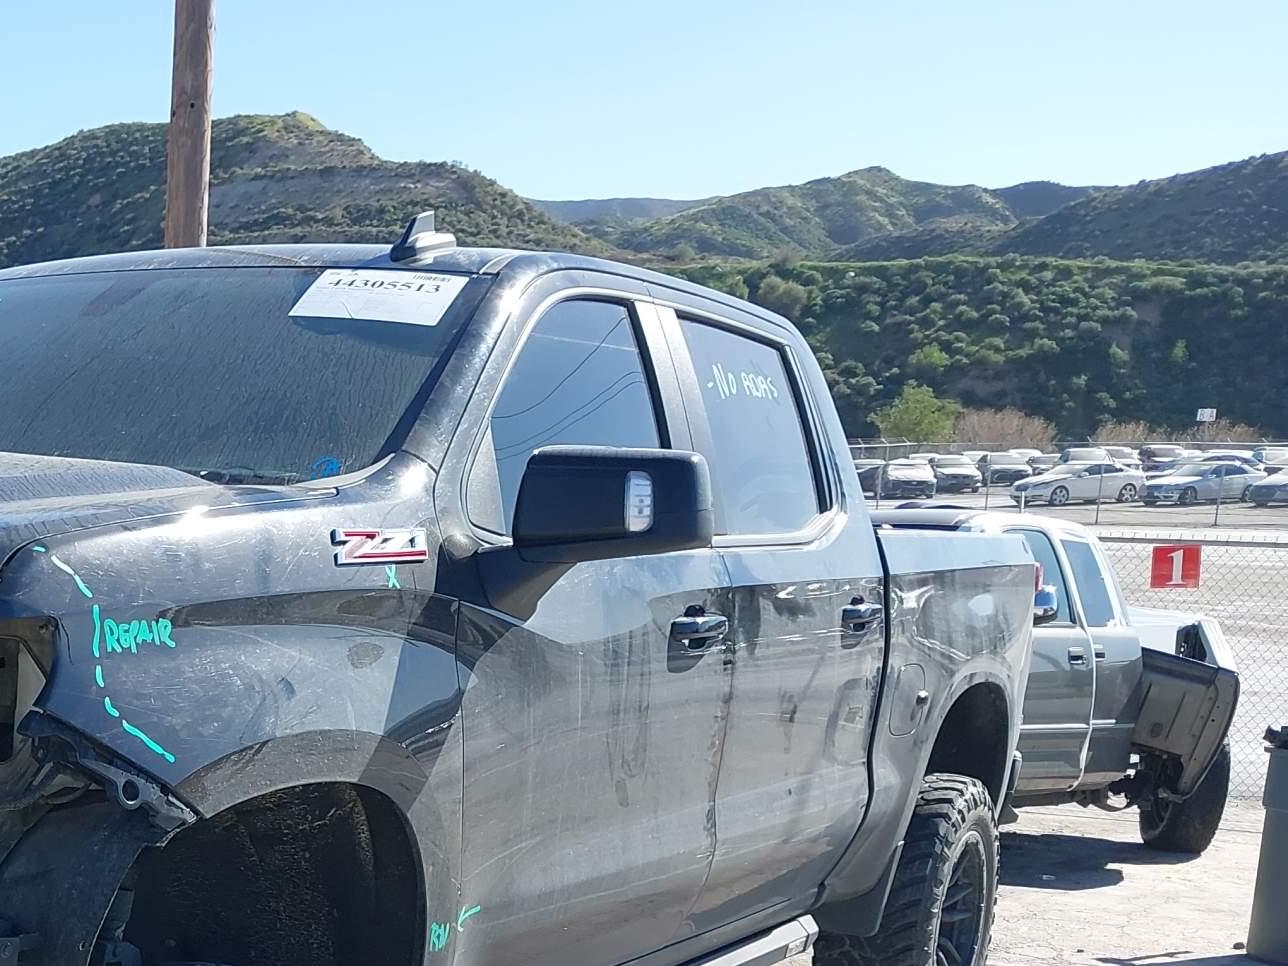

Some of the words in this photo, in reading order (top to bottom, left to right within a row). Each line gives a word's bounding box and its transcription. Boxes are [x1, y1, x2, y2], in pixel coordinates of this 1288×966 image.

[328, 278, 441, 294] 44305513
[1165, 549, 1187, 585] 1
[104, 618, 175, 654] REPAIR
